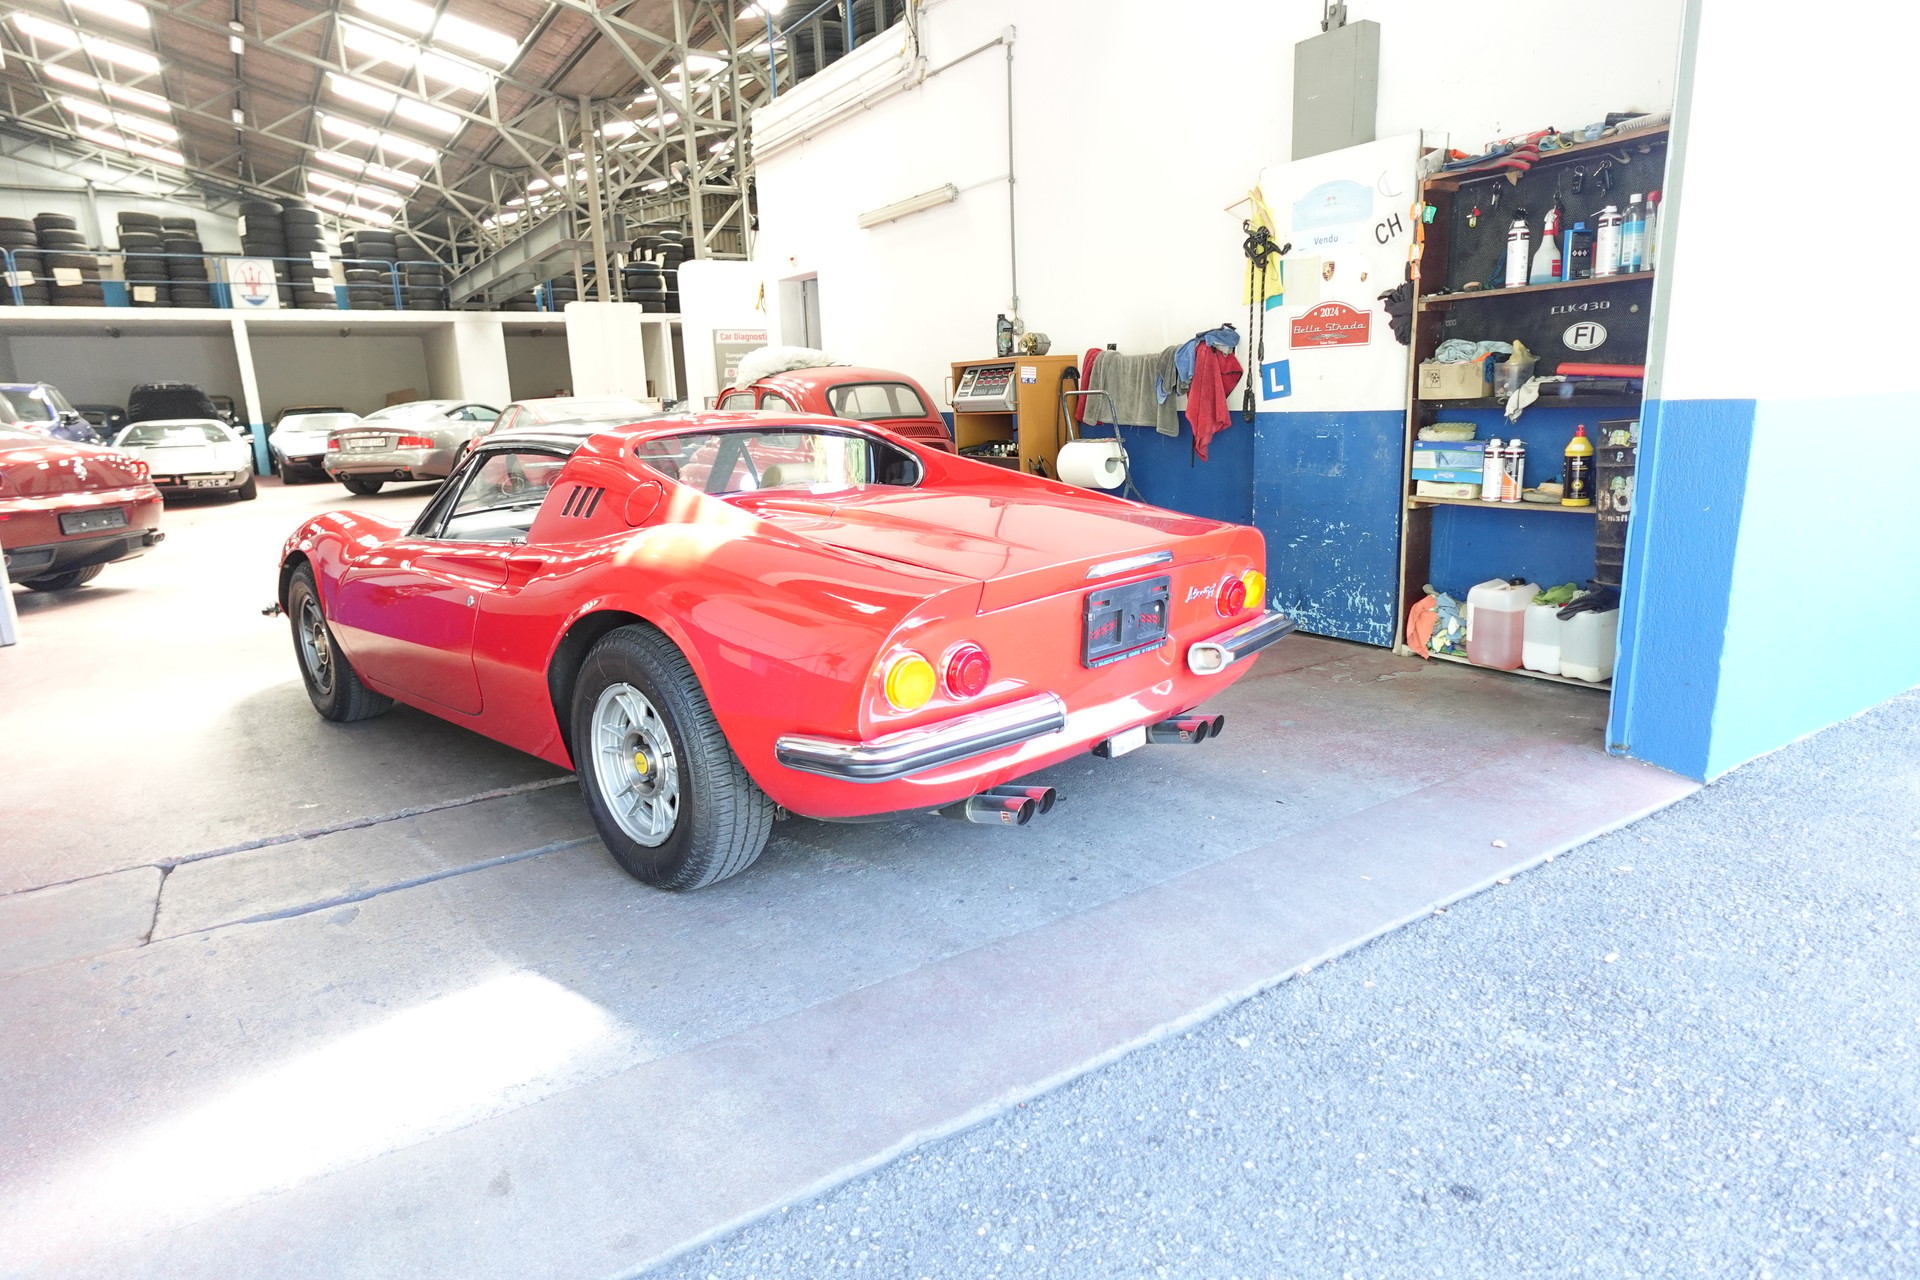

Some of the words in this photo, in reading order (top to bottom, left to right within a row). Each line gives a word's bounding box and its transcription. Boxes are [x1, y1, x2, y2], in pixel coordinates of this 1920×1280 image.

[1375, 212, 1403, 244] CH
[1313, 234, 1339, 246] Vendu
[1320, 306, 1340, 317] 2024
[1551, 301, 1610, 315] CLK430
[1293, 325, 1322, 334] Bella
[1325, 321, 1367, 332] Strada
[720, 333, 732, 341] Car
[1574, 326, 1596, 345] FI
[1270, 367, 1285, 393] L
